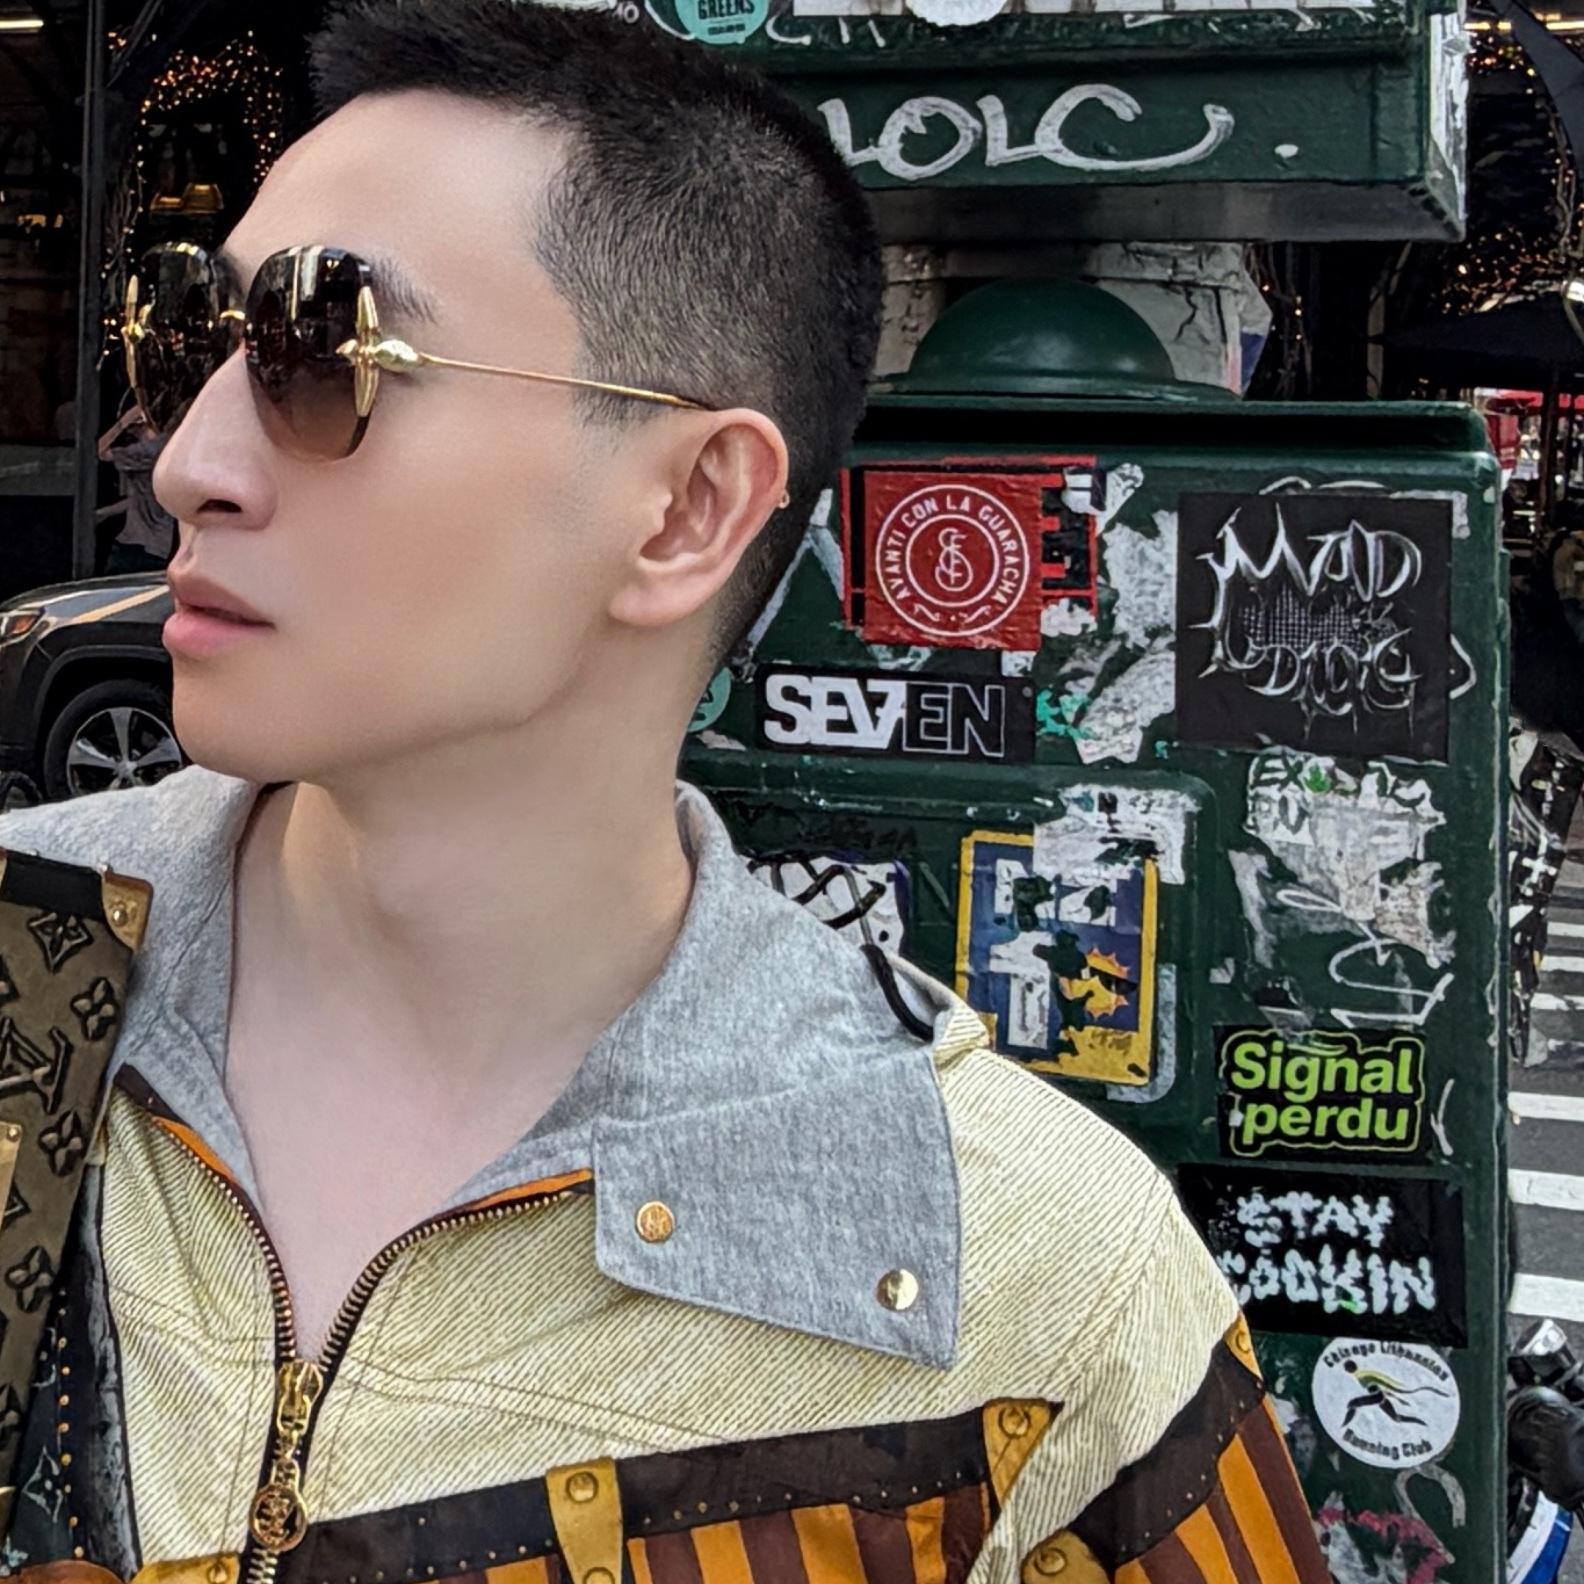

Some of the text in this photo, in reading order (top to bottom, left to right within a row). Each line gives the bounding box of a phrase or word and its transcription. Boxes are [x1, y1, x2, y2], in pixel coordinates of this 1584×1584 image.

[884, 495, 1020, 605] AVANTI CON LA GUARACHA
[1231, 1040, 1413, 1098] Signal
[1241, 1096, 1410, 1146] perdu
[1237, 1190, 1394, 1248] STAY
[1322, 1340, 1450, 1382] Chicago Lithuanian
[1342, 1428, 1433, 1461] Running Club
